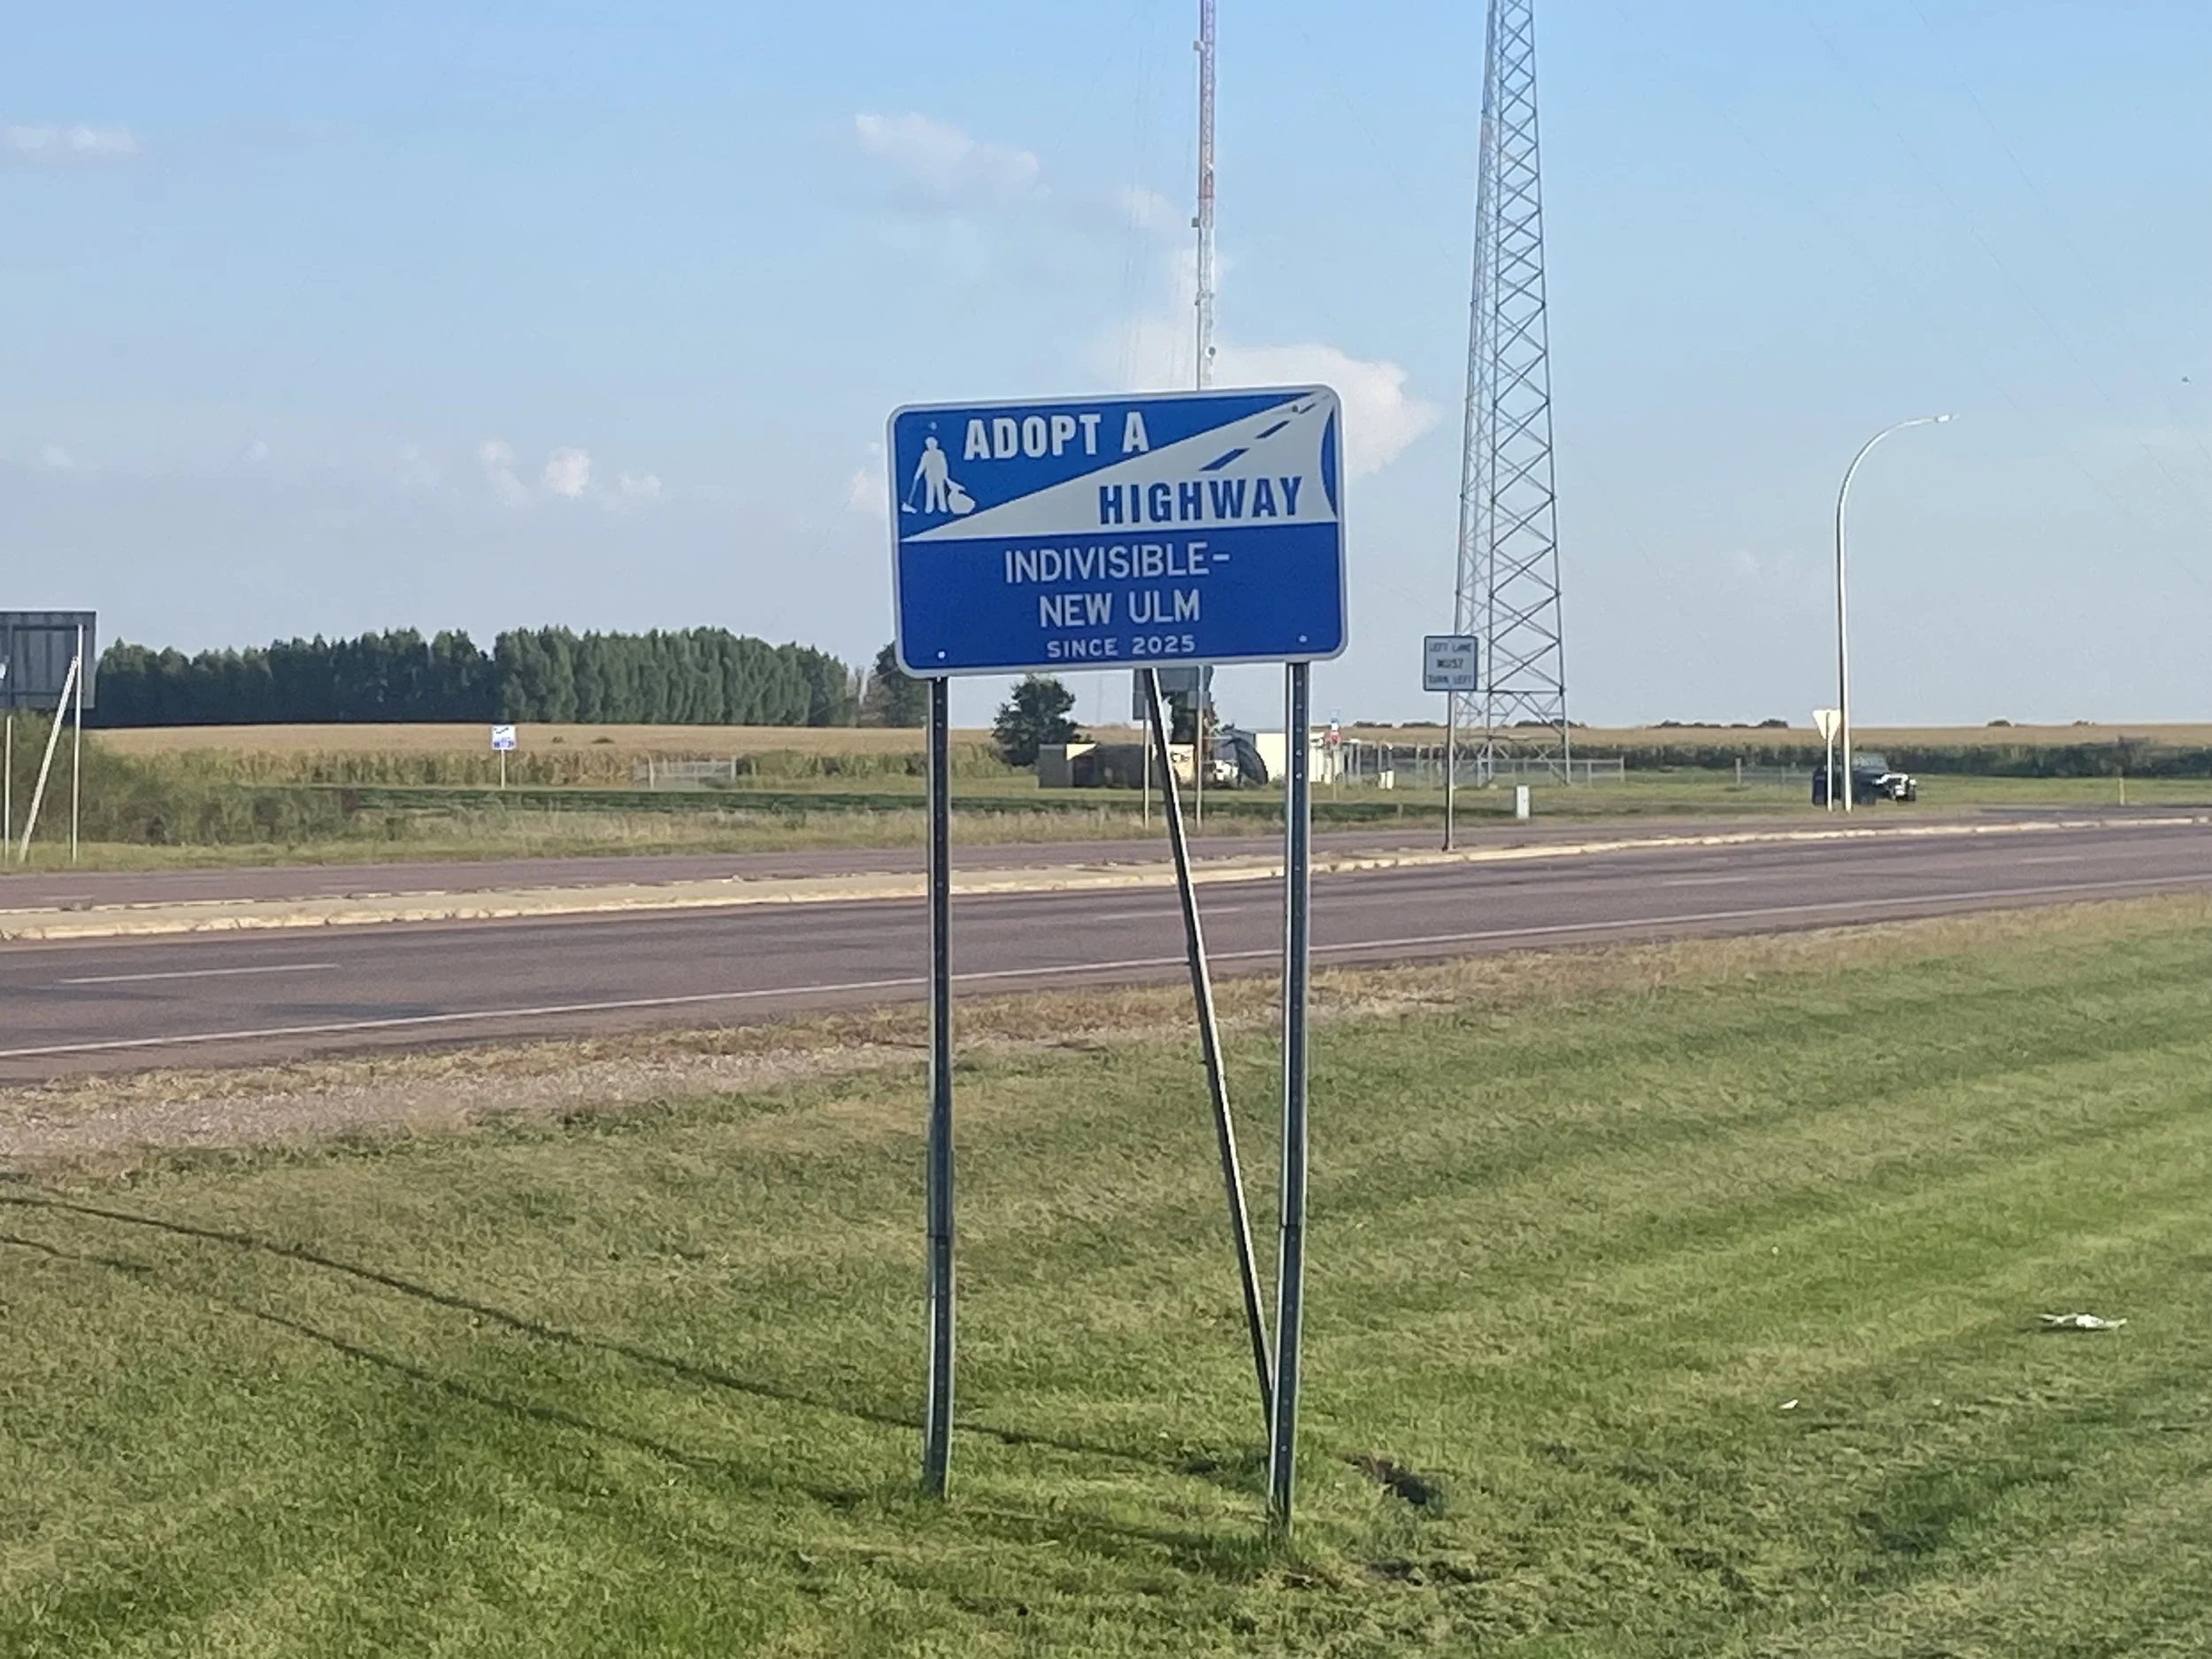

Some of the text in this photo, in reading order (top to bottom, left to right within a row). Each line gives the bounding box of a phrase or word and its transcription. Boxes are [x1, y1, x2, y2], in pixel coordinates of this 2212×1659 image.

[963, 411, 1150, 460] ADOPT A
[1098, 476, 1302, 525] HIGHWAY
[1005, 541, 1231, 584] INDIVISIBLE-
[1039, 588, 1201, 627] NEW ULM
[1047, 634, 1195, 658] SINCE 2025
